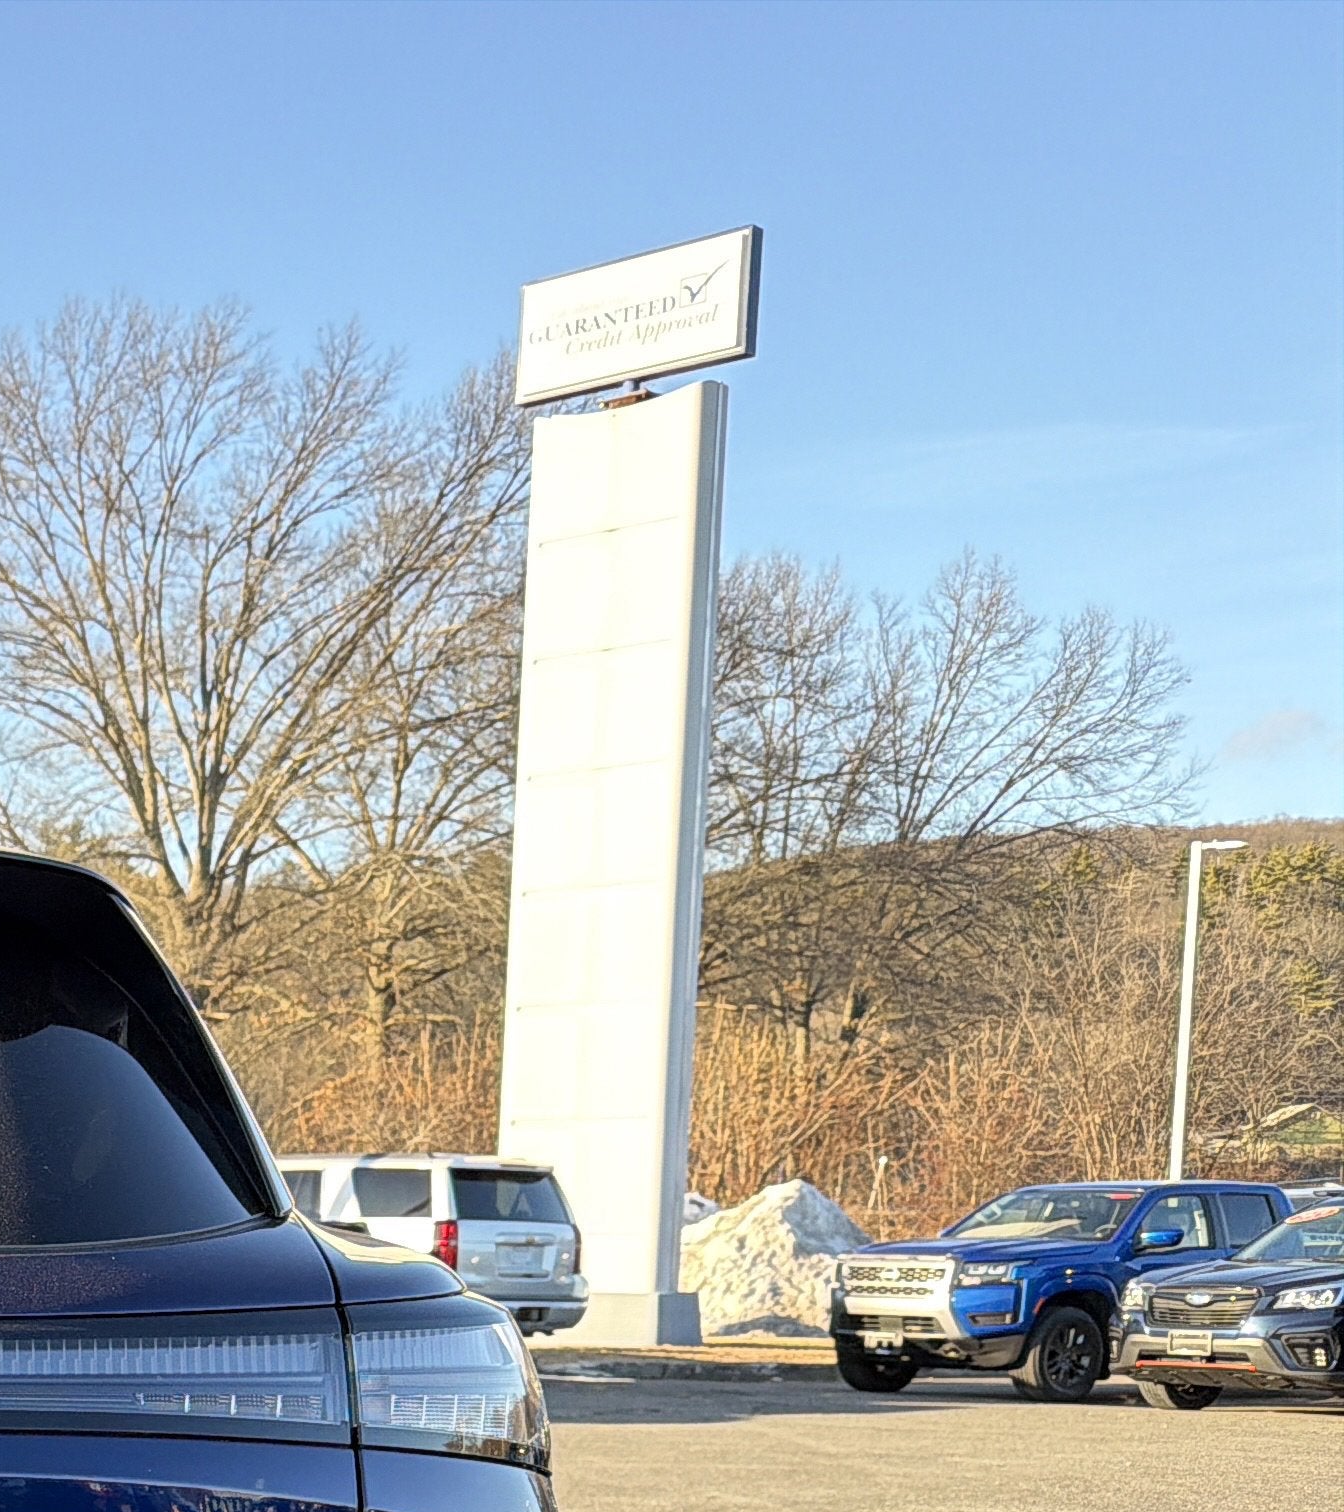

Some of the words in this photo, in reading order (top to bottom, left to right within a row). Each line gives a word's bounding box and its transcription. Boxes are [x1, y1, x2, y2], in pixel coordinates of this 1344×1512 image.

[529, 295, 676, 345] GUARANTEED
[565, 329, 622, 355] Credit
[629, 303, 719, 346] Approval
